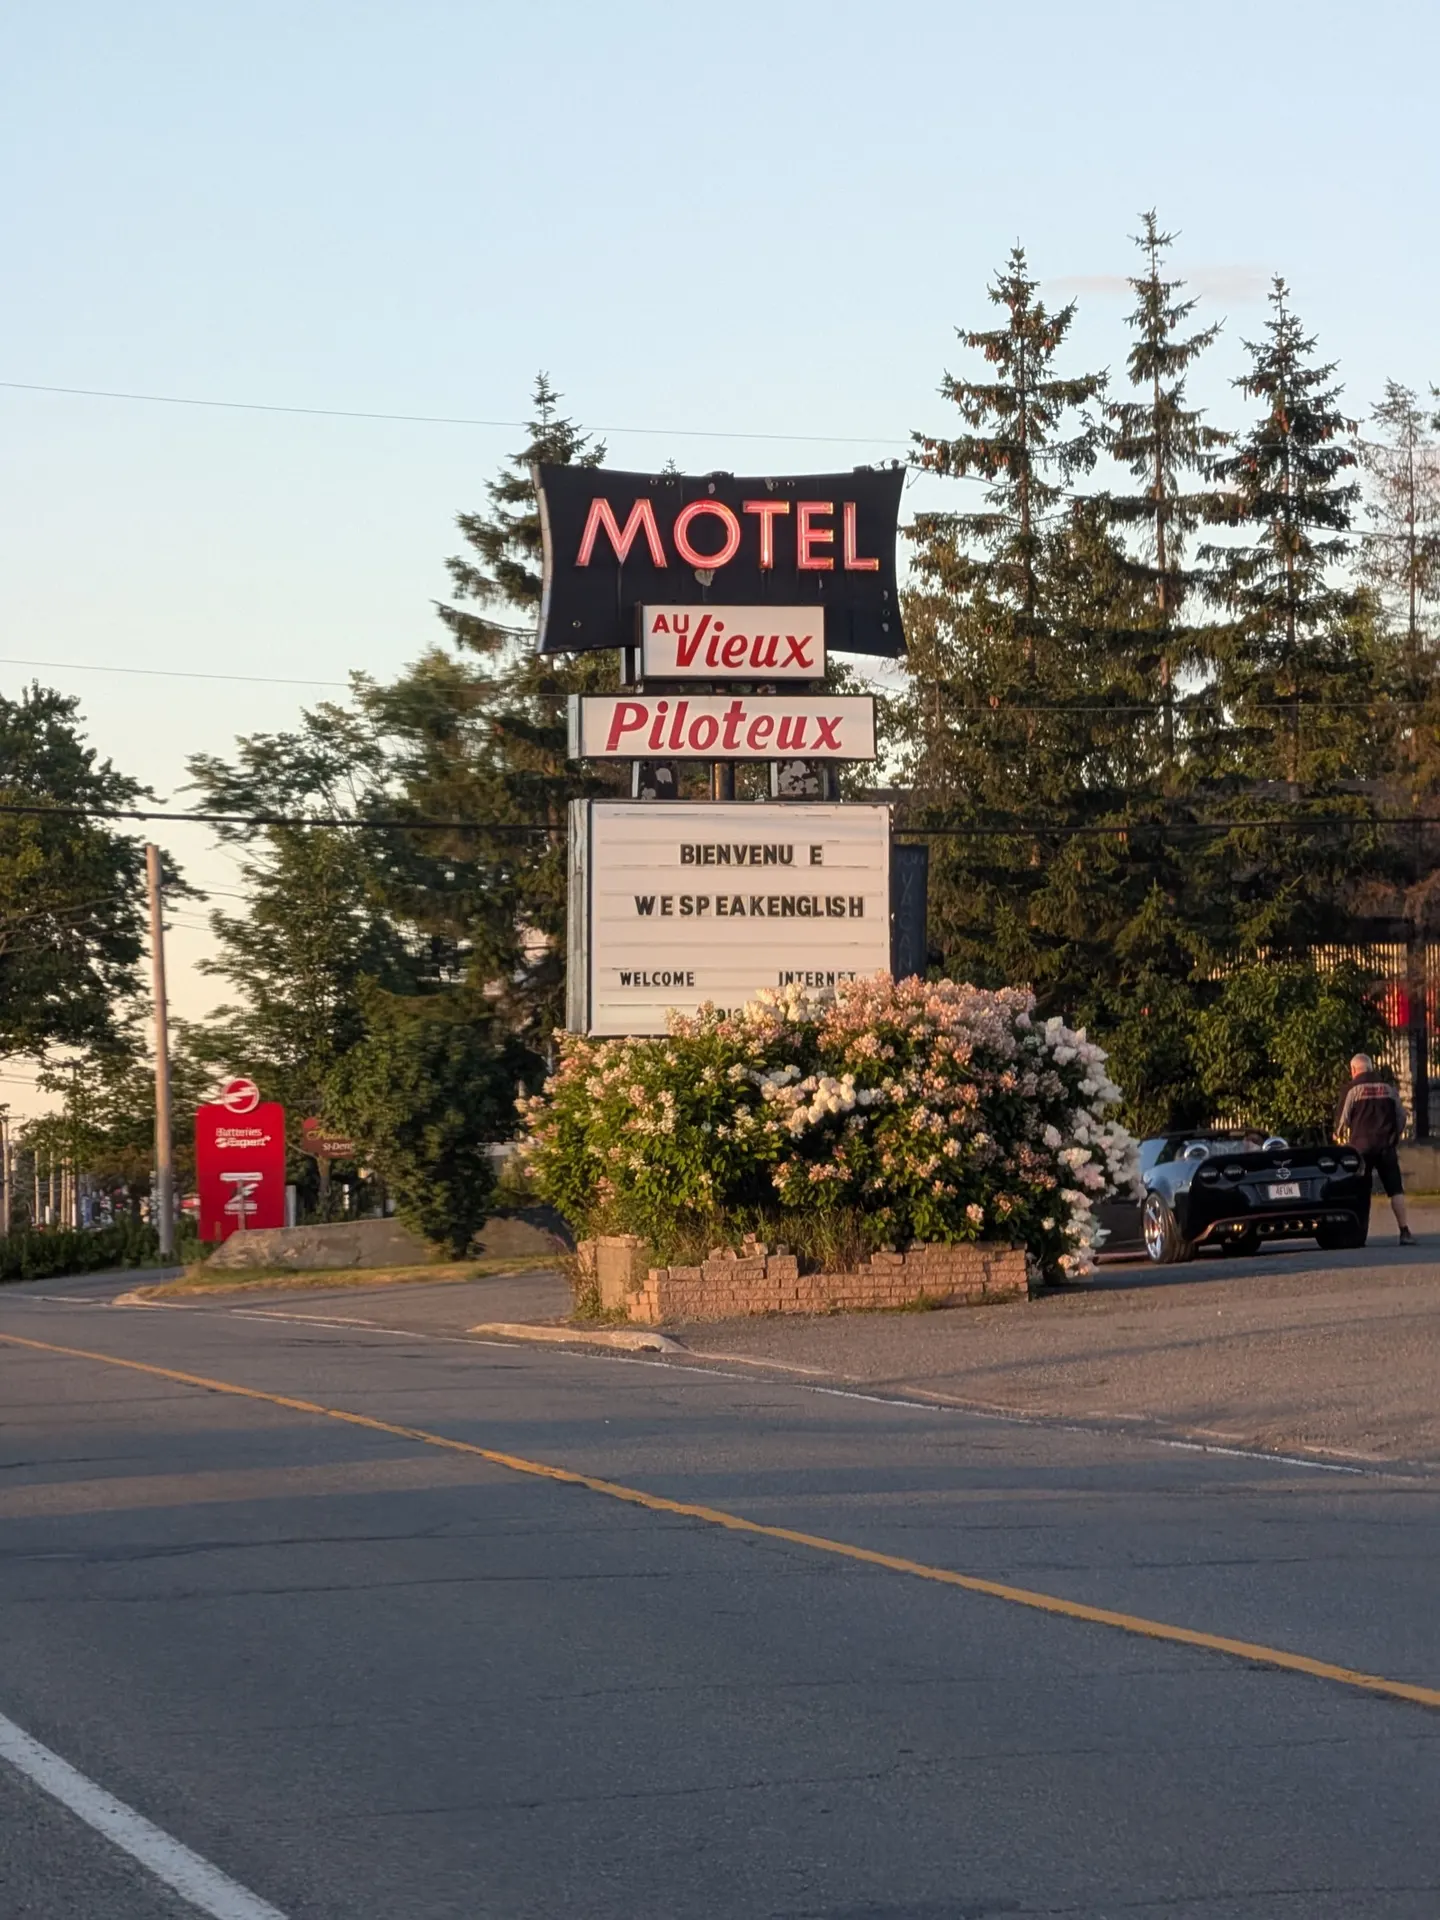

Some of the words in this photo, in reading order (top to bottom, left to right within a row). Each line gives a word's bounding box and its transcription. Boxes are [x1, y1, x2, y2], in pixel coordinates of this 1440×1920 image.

[576, 498, 879, 570] MOTEL
[652, 614, 689, 633] AU
[676, 615, 814, 668] Vieux
[606, 701, 843, 752] Piloteux
[680, 844, 793, 865] BIENVENU
[620, 971, 695, 986] WELCOME
